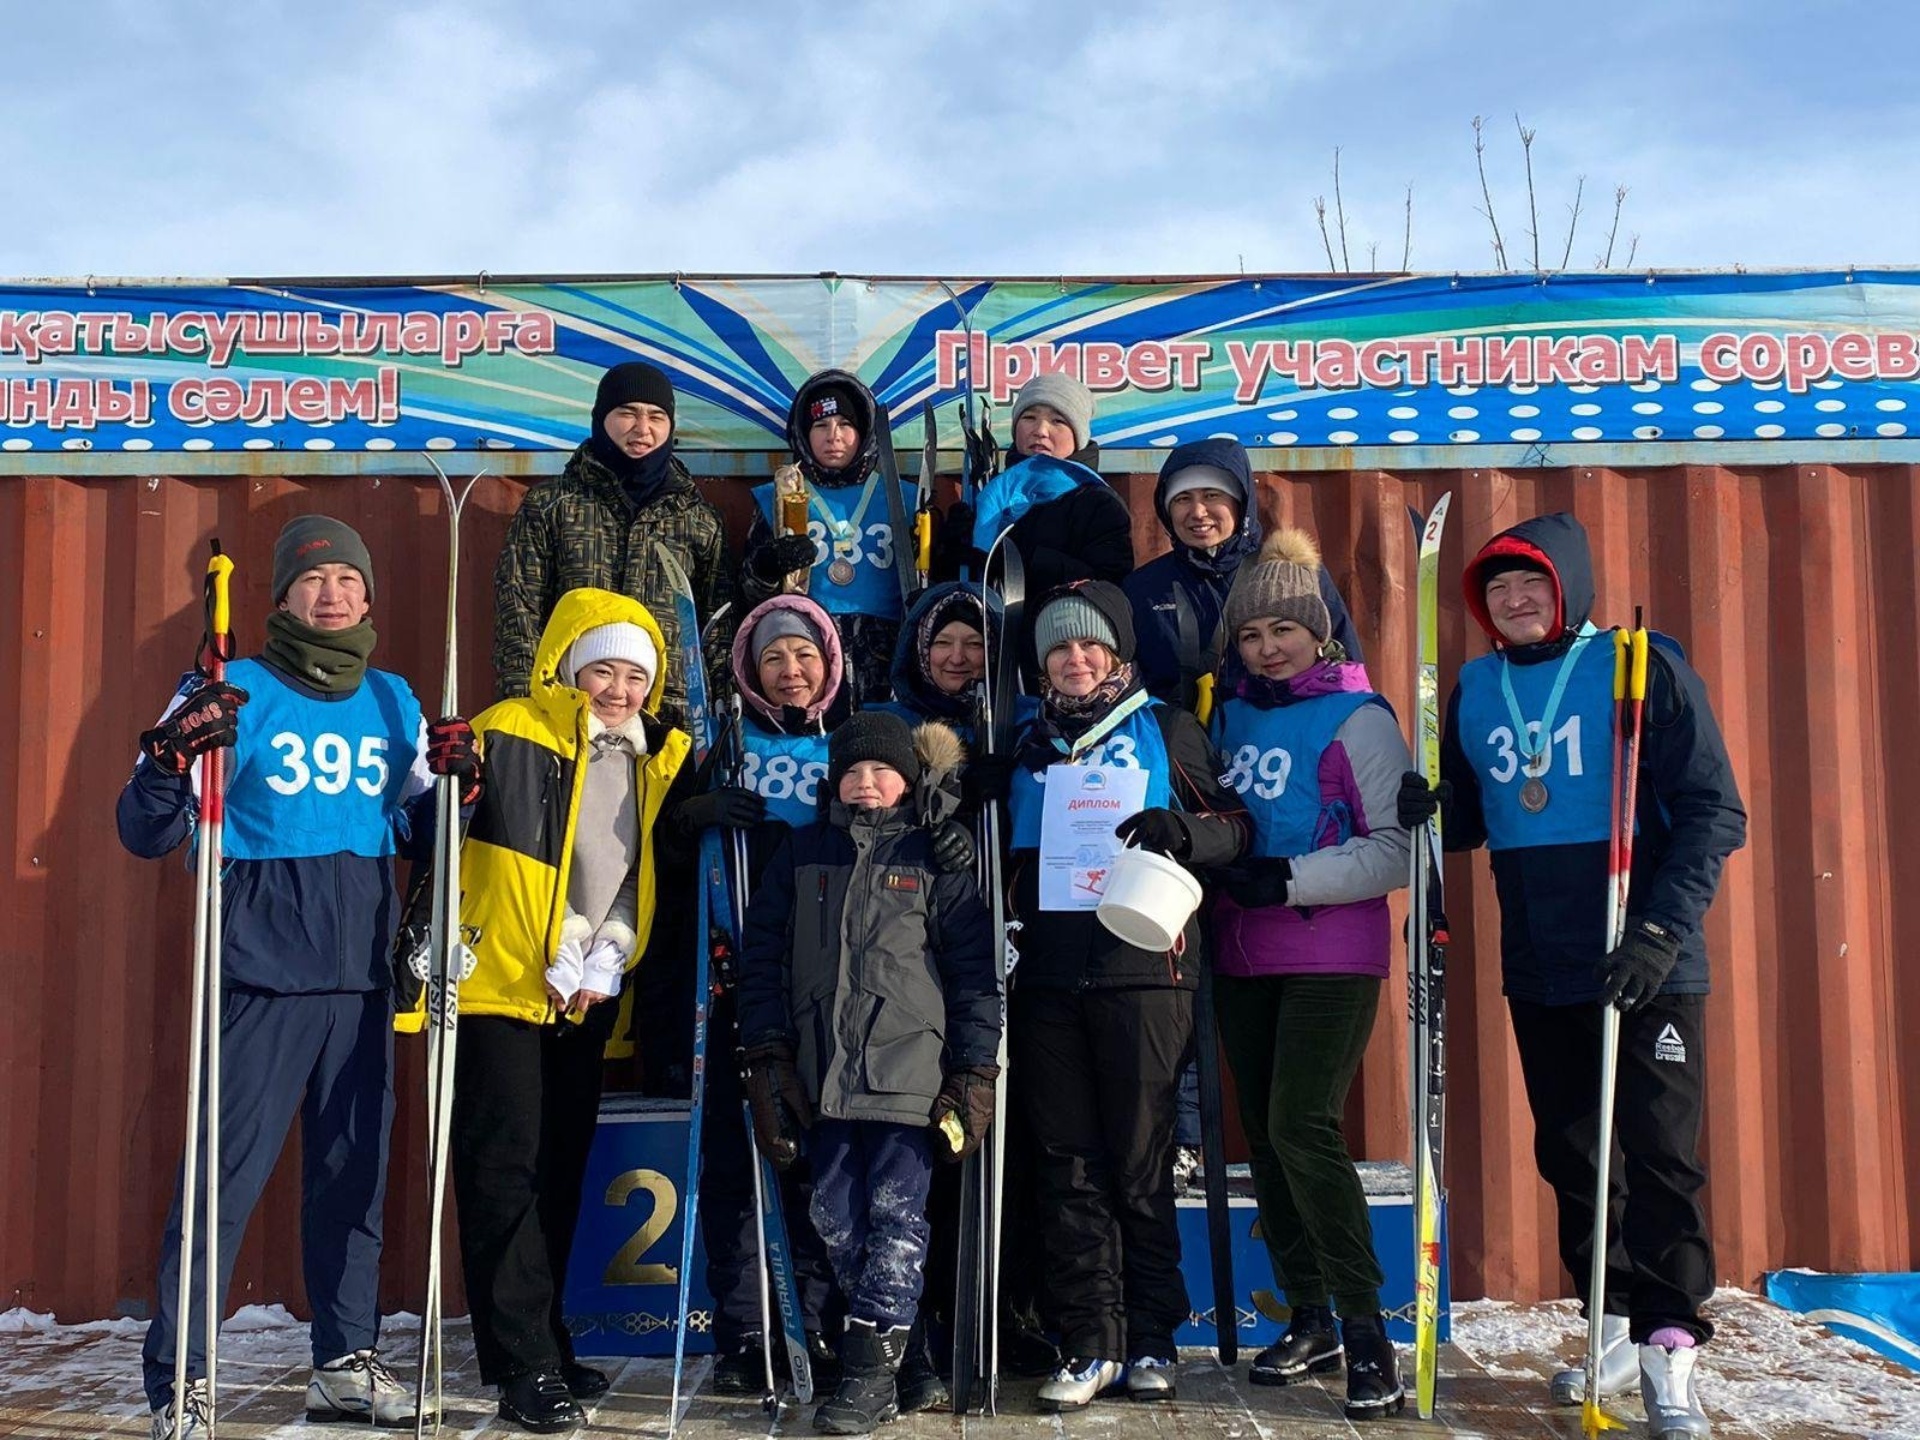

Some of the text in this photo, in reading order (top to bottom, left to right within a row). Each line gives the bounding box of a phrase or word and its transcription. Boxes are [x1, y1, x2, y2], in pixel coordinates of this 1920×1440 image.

[0, 311, 556, 366] қатысушыларға
[936, 329, 1920, 404] Привет участникам сорев
[0, 368, 399, 428] нды сәлем!
[1426, 521, 1437, 541] 2
[266, 731, 390, 797] 395
[1222, 744, 1292, 800] 89
[1487, 715, 1583, 783] 391
[1068, 799, 1121, 811] ДИПЛОМ
[603, 1168, 678, 1285] 2
[770, 1242, 795, 1329] FORMULA
